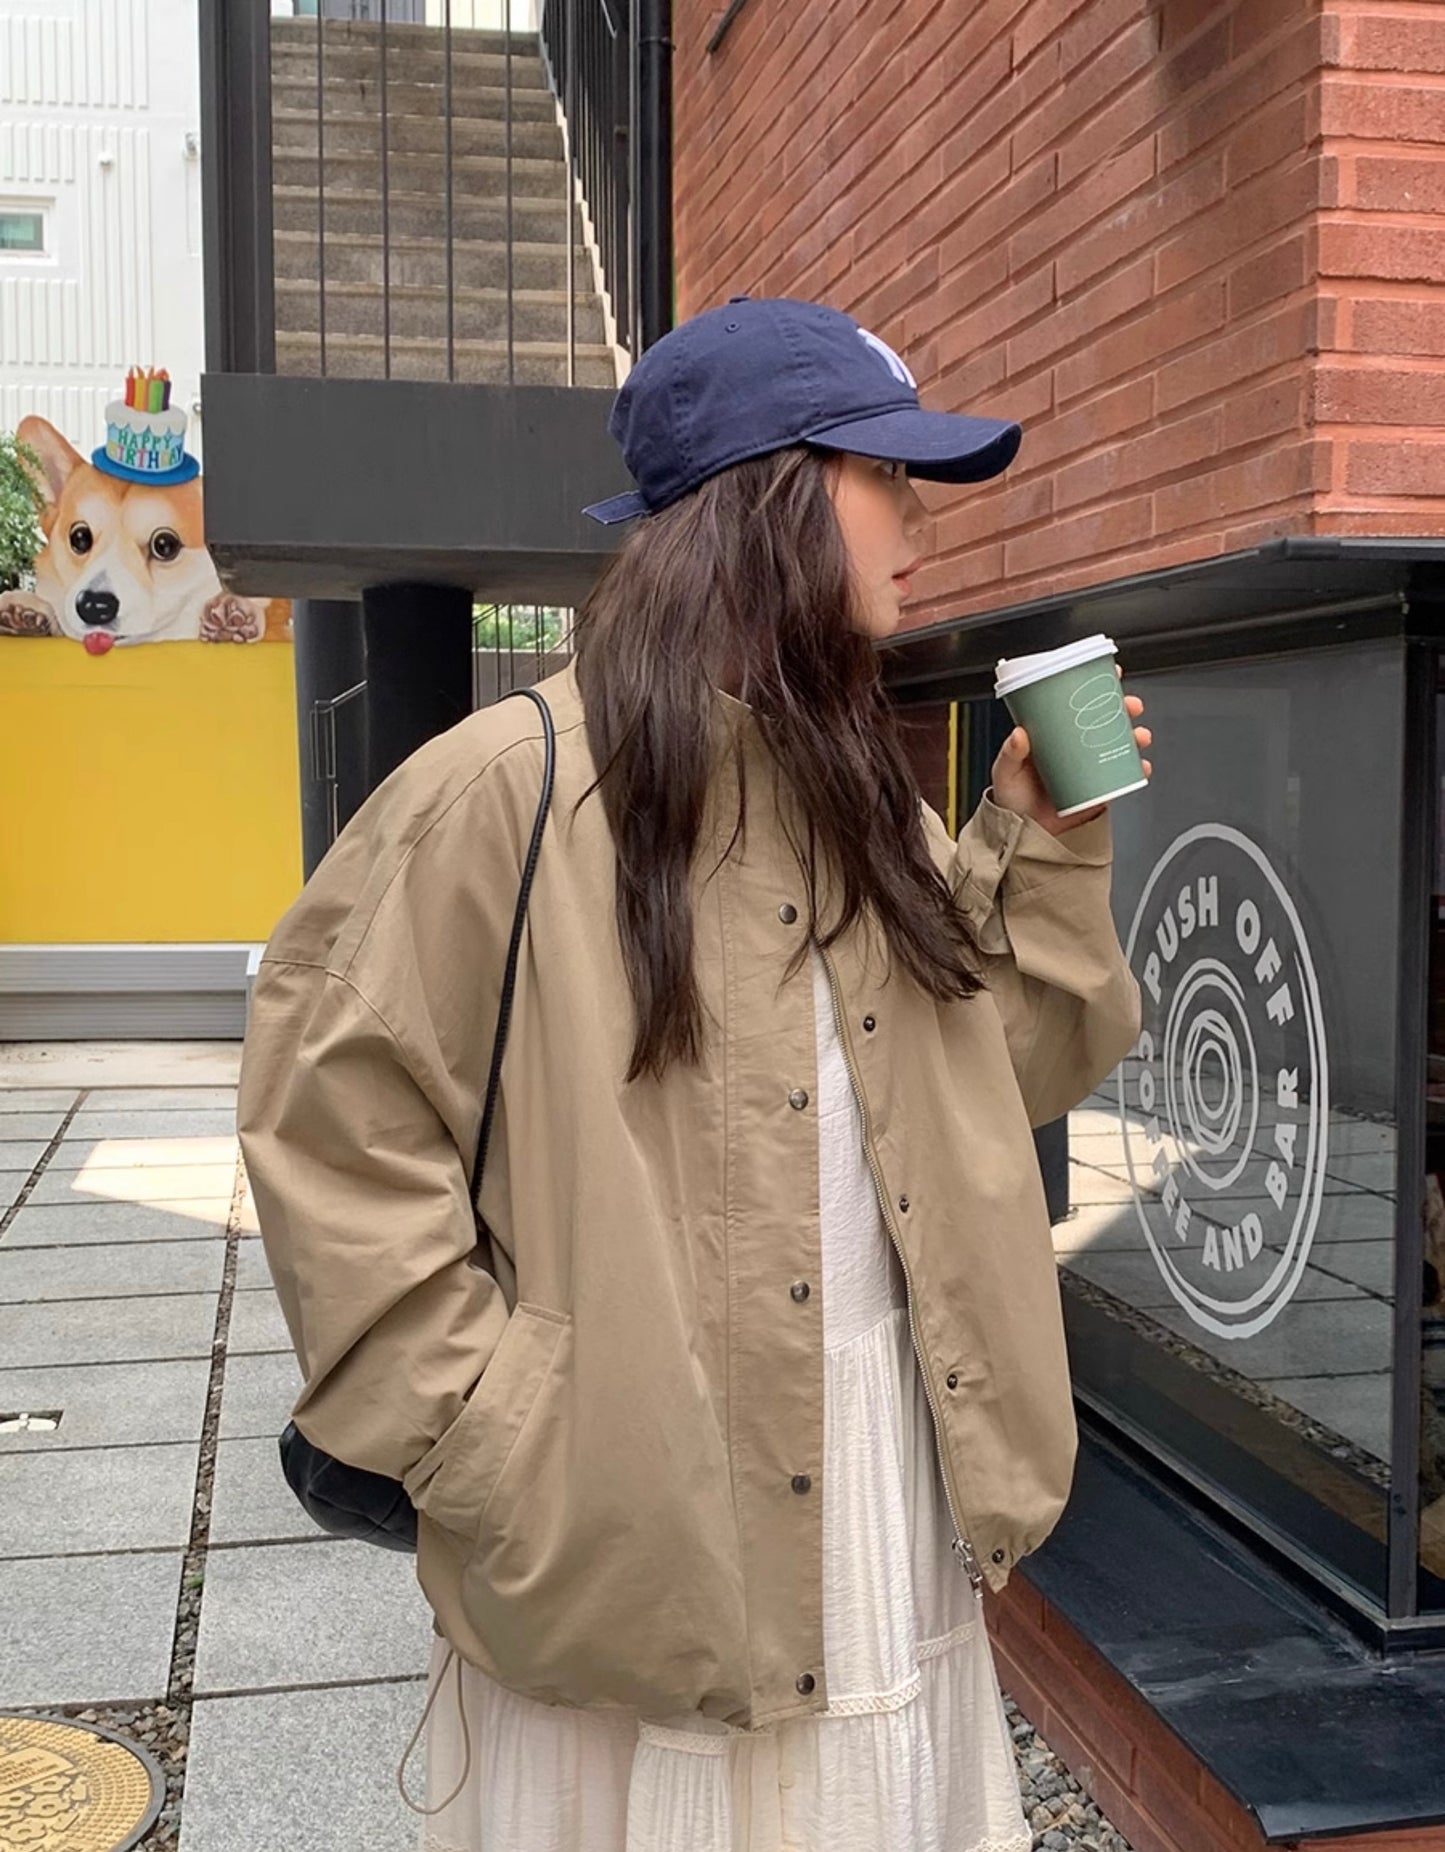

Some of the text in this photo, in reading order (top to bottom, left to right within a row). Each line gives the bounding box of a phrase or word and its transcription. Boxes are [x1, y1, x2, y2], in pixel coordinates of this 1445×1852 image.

[118, 428, 173, 450] HAPPY
[1143, 875, 1295, 1026] PUSH OFF
[1138, 1030, 1298, 1272] COFFEE AND BAR
